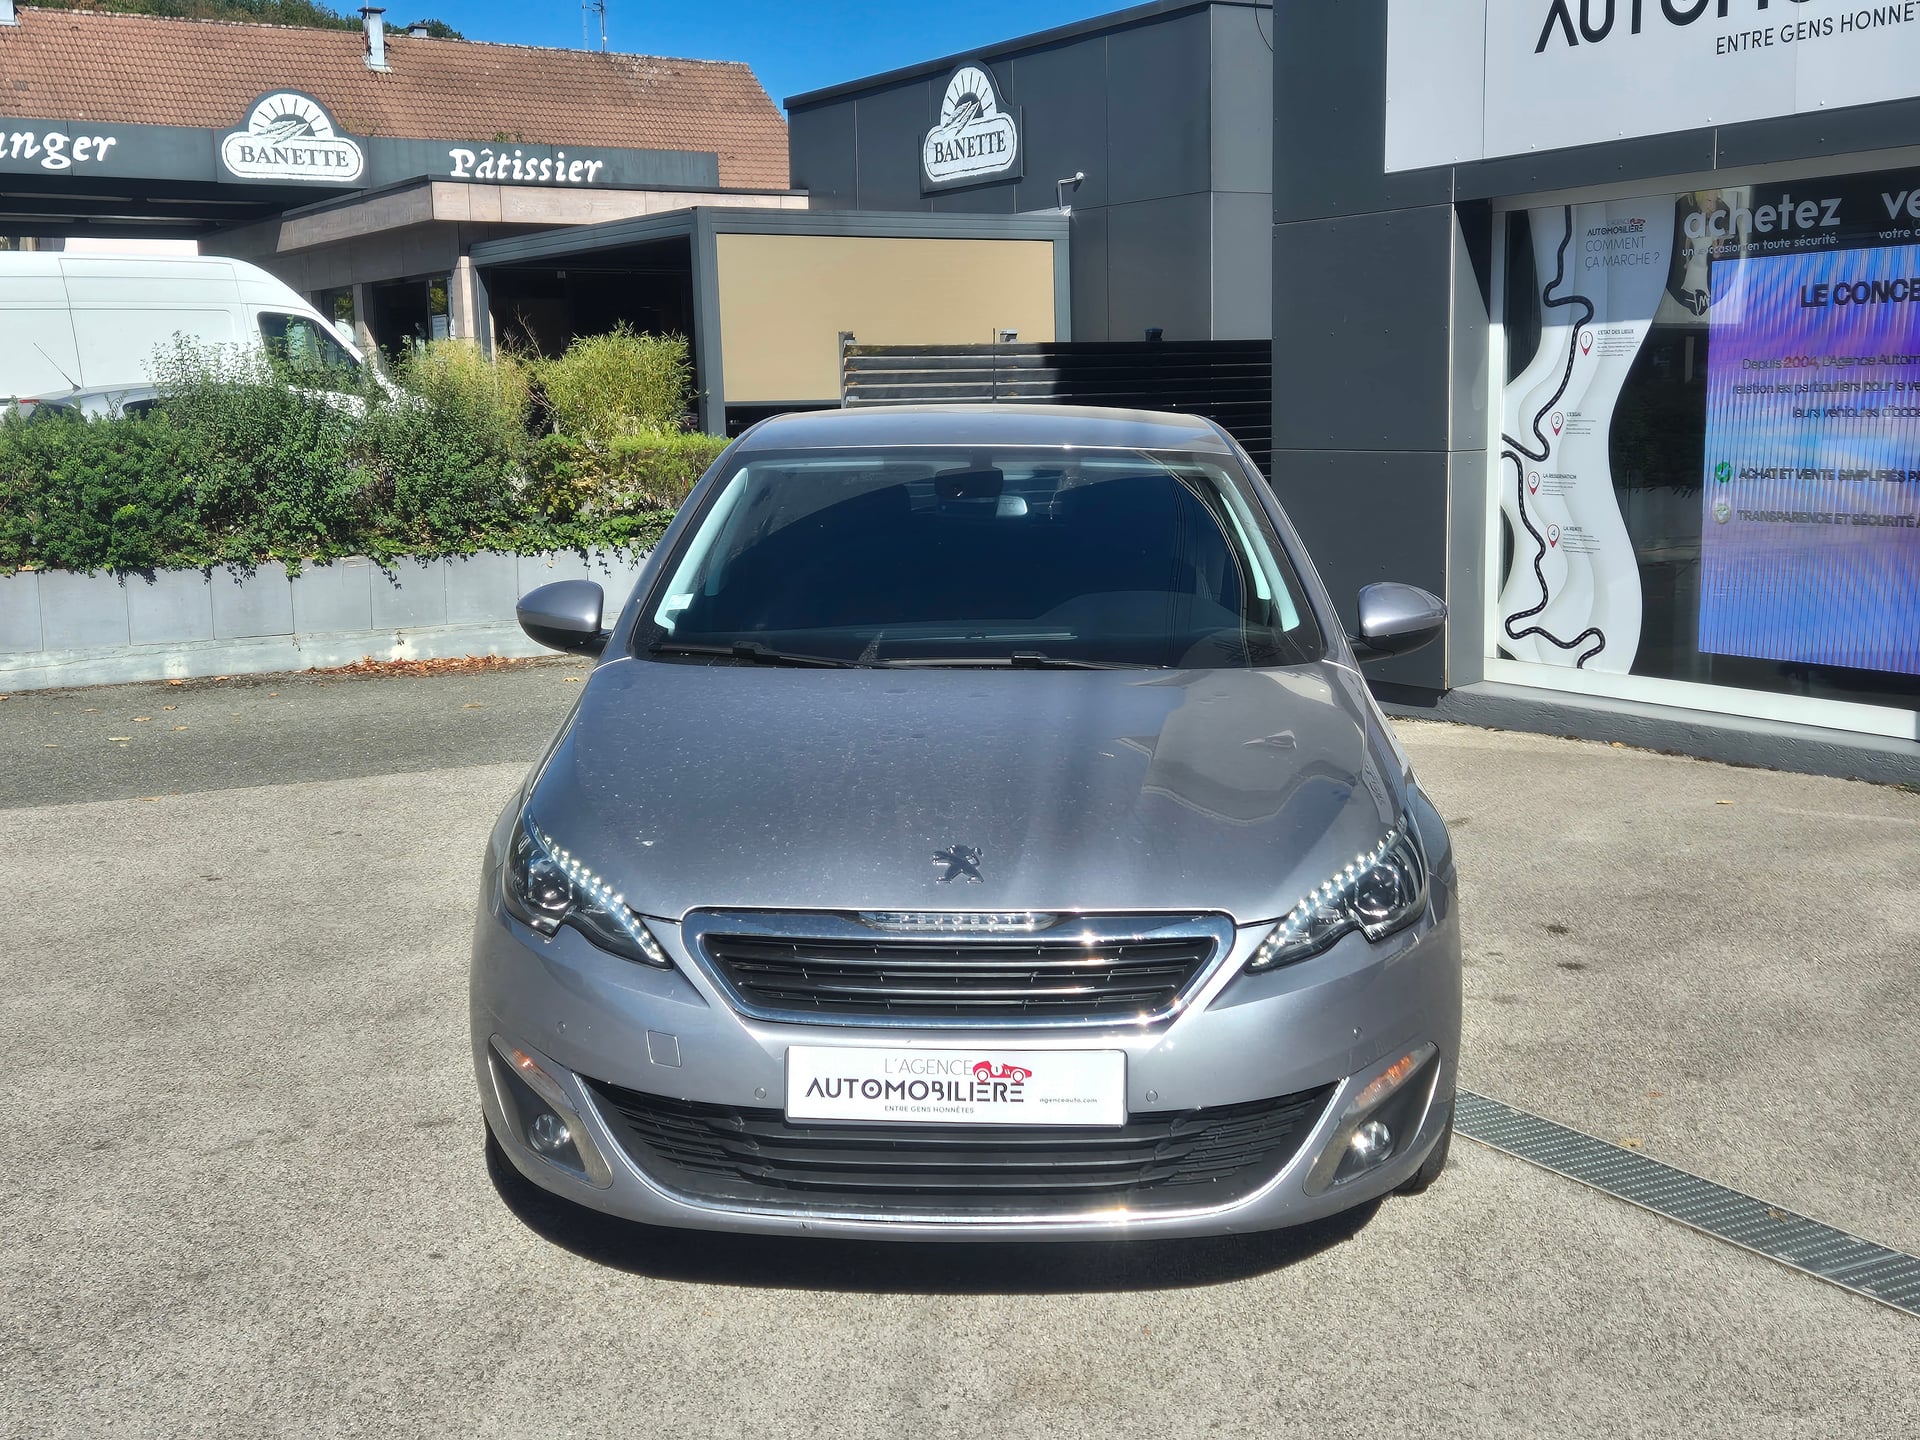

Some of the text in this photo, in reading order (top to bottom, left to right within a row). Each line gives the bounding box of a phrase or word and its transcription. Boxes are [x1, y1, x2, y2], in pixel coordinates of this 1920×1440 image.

[1716, 28, 1775, 55] ENTRE
[1780, 17, 1833, 43] GENS
[239, 144, 349, 167] BANETTE
[933, 129, 1007, 165] BANETTE
[448, 148, 603, 183] Pâtissier
[1683, 194, 1842, 240] achetez
[1585, 235, 1646, 253] COMMENT
[1762, 238, 1791, 250] toute
[1794, 231, 1840, 247] sécurité.
[1878, 228, 1911, 239] votre
[1585, 251, 1660, 271] ÇA MARCHE ?
[1801, 283, 1828, 307] LE
[1737, 509, 1833, 524] TRANSPARENCE
[885, 1058, 973, 1076] L'AGENCE
